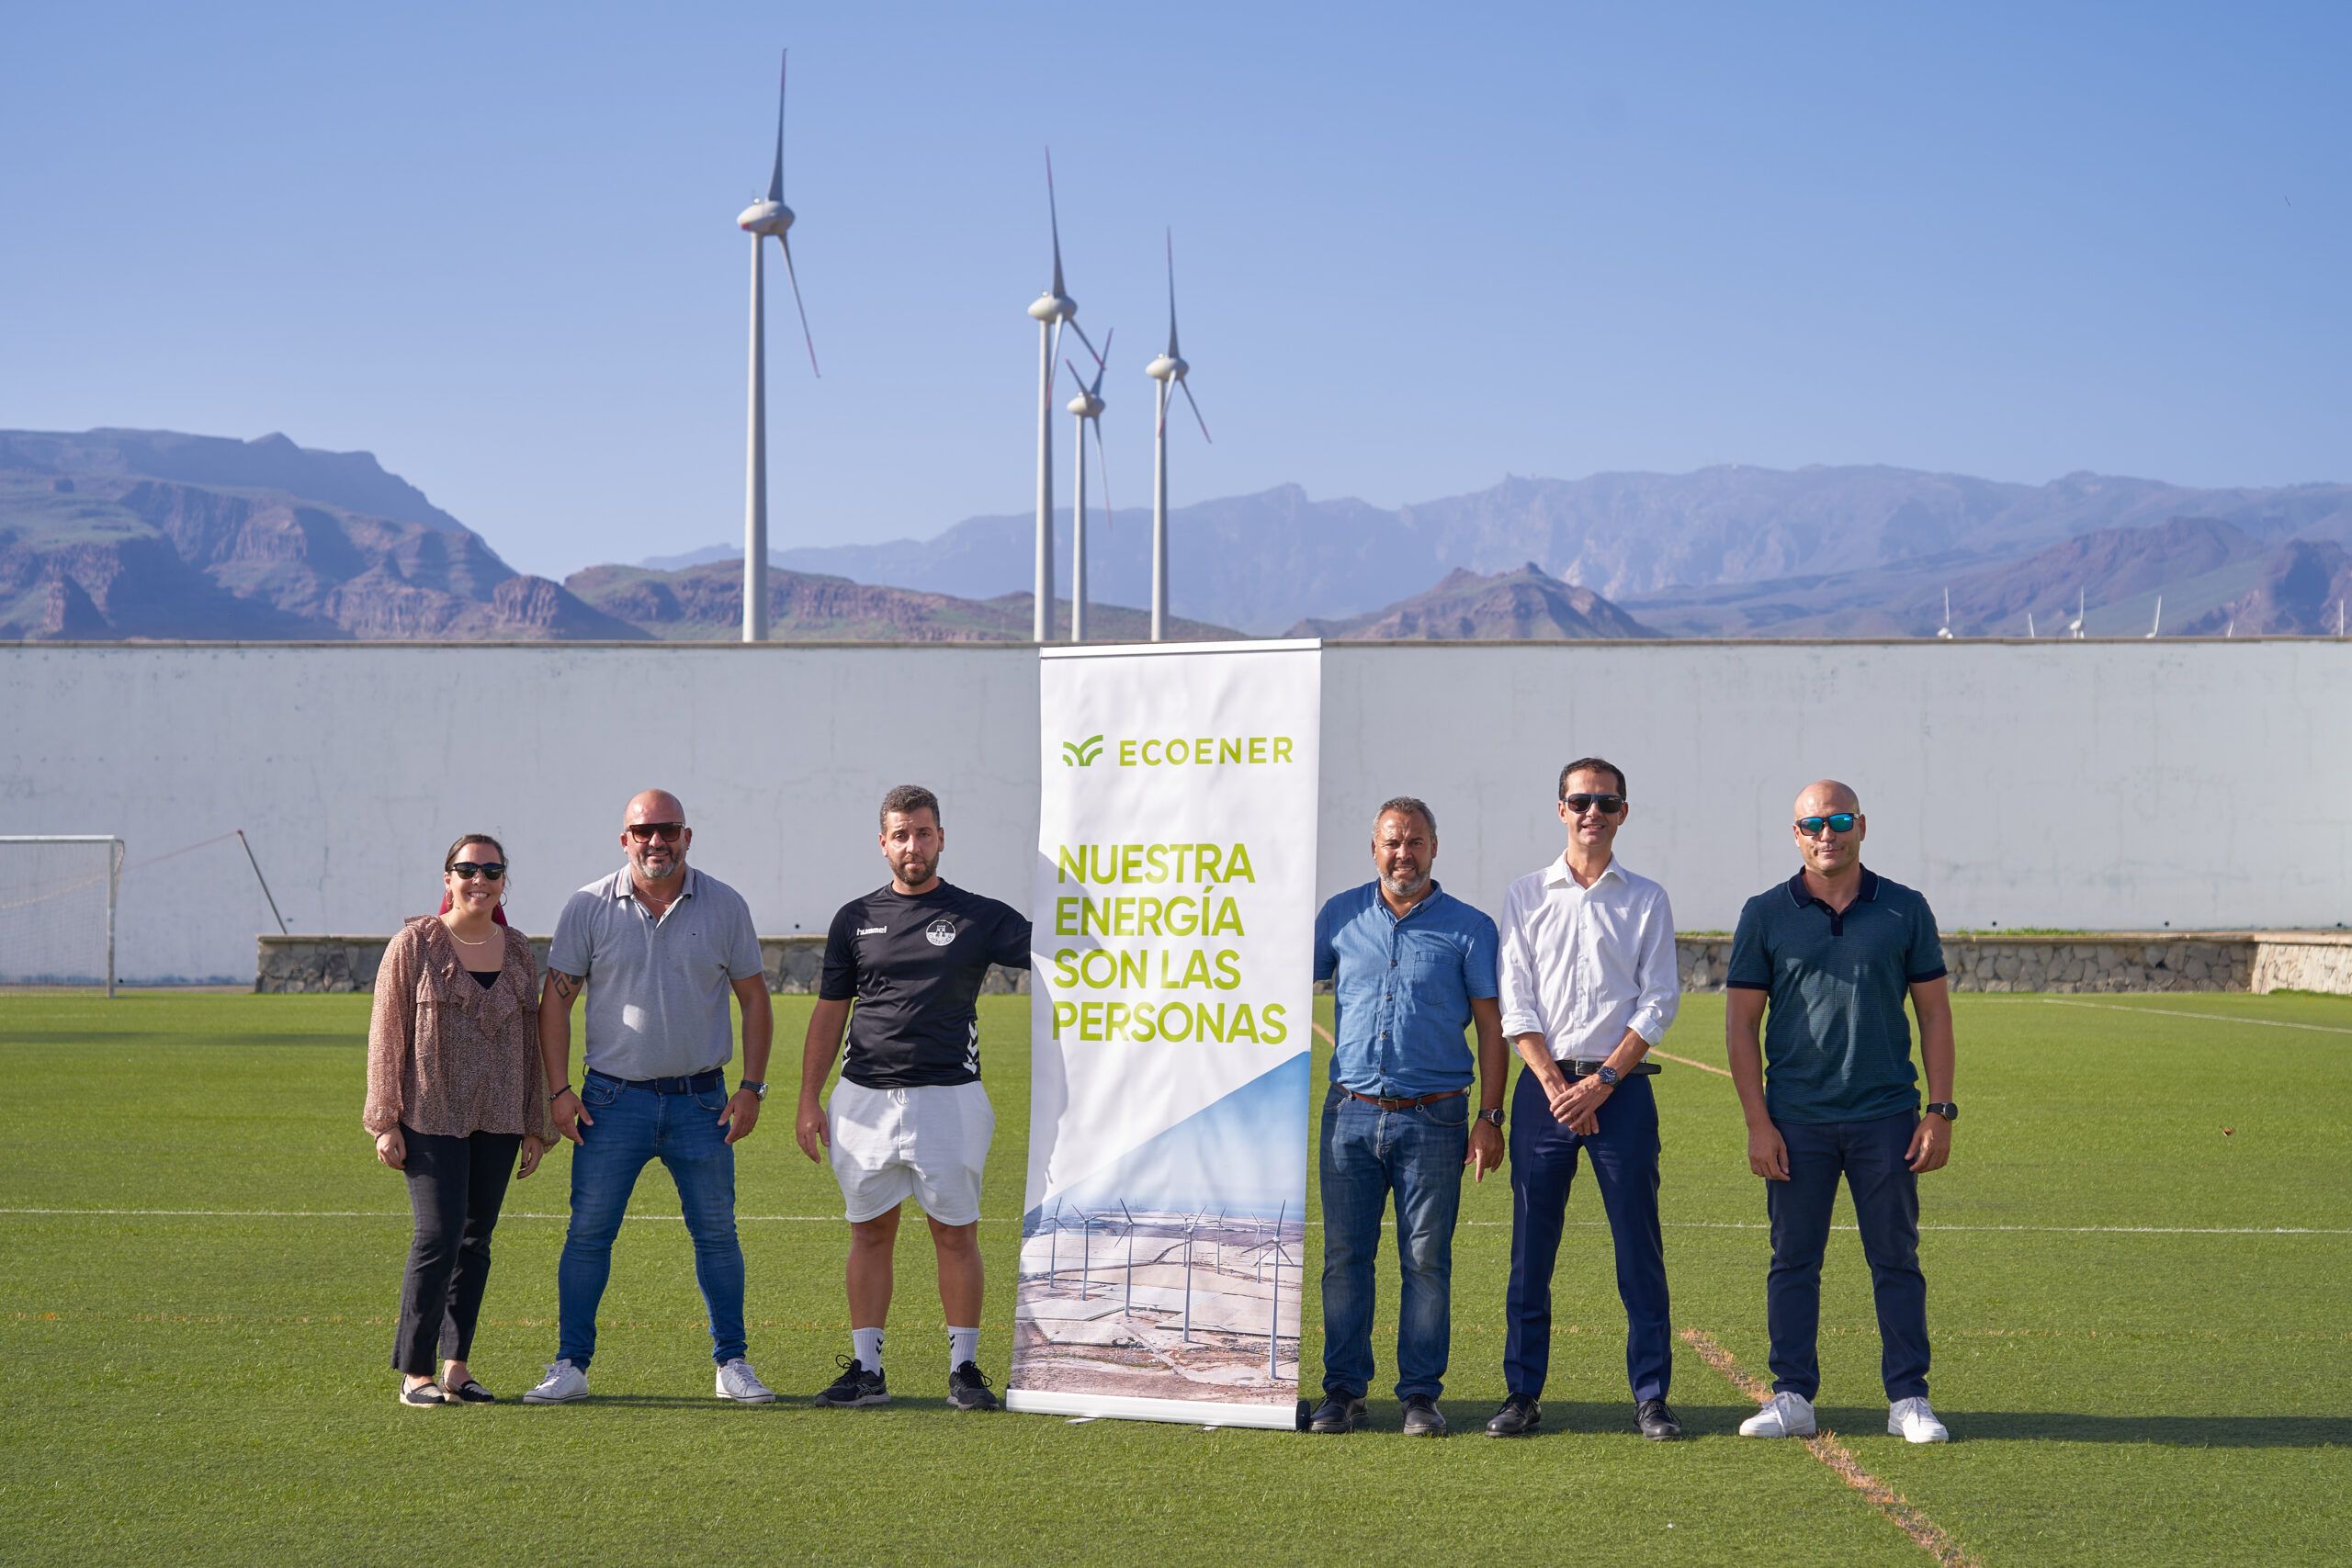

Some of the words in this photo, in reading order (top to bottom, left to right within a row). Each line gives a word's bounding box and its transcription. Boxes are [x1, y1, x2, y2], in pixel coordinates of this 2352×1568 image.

[1119, 737, 1293, 766] ECOENER
[1057, 843, 1256, 884] NUESTRA
[856, 926, 888, 936] hummel
[1056, 886, 1245, 937] ENERGÍA
[1053, 949, 1148, 989] SON
[1160, 950, 1241, 990] LAS
[1052, 1001, 1287, 1045] PERSONAS
